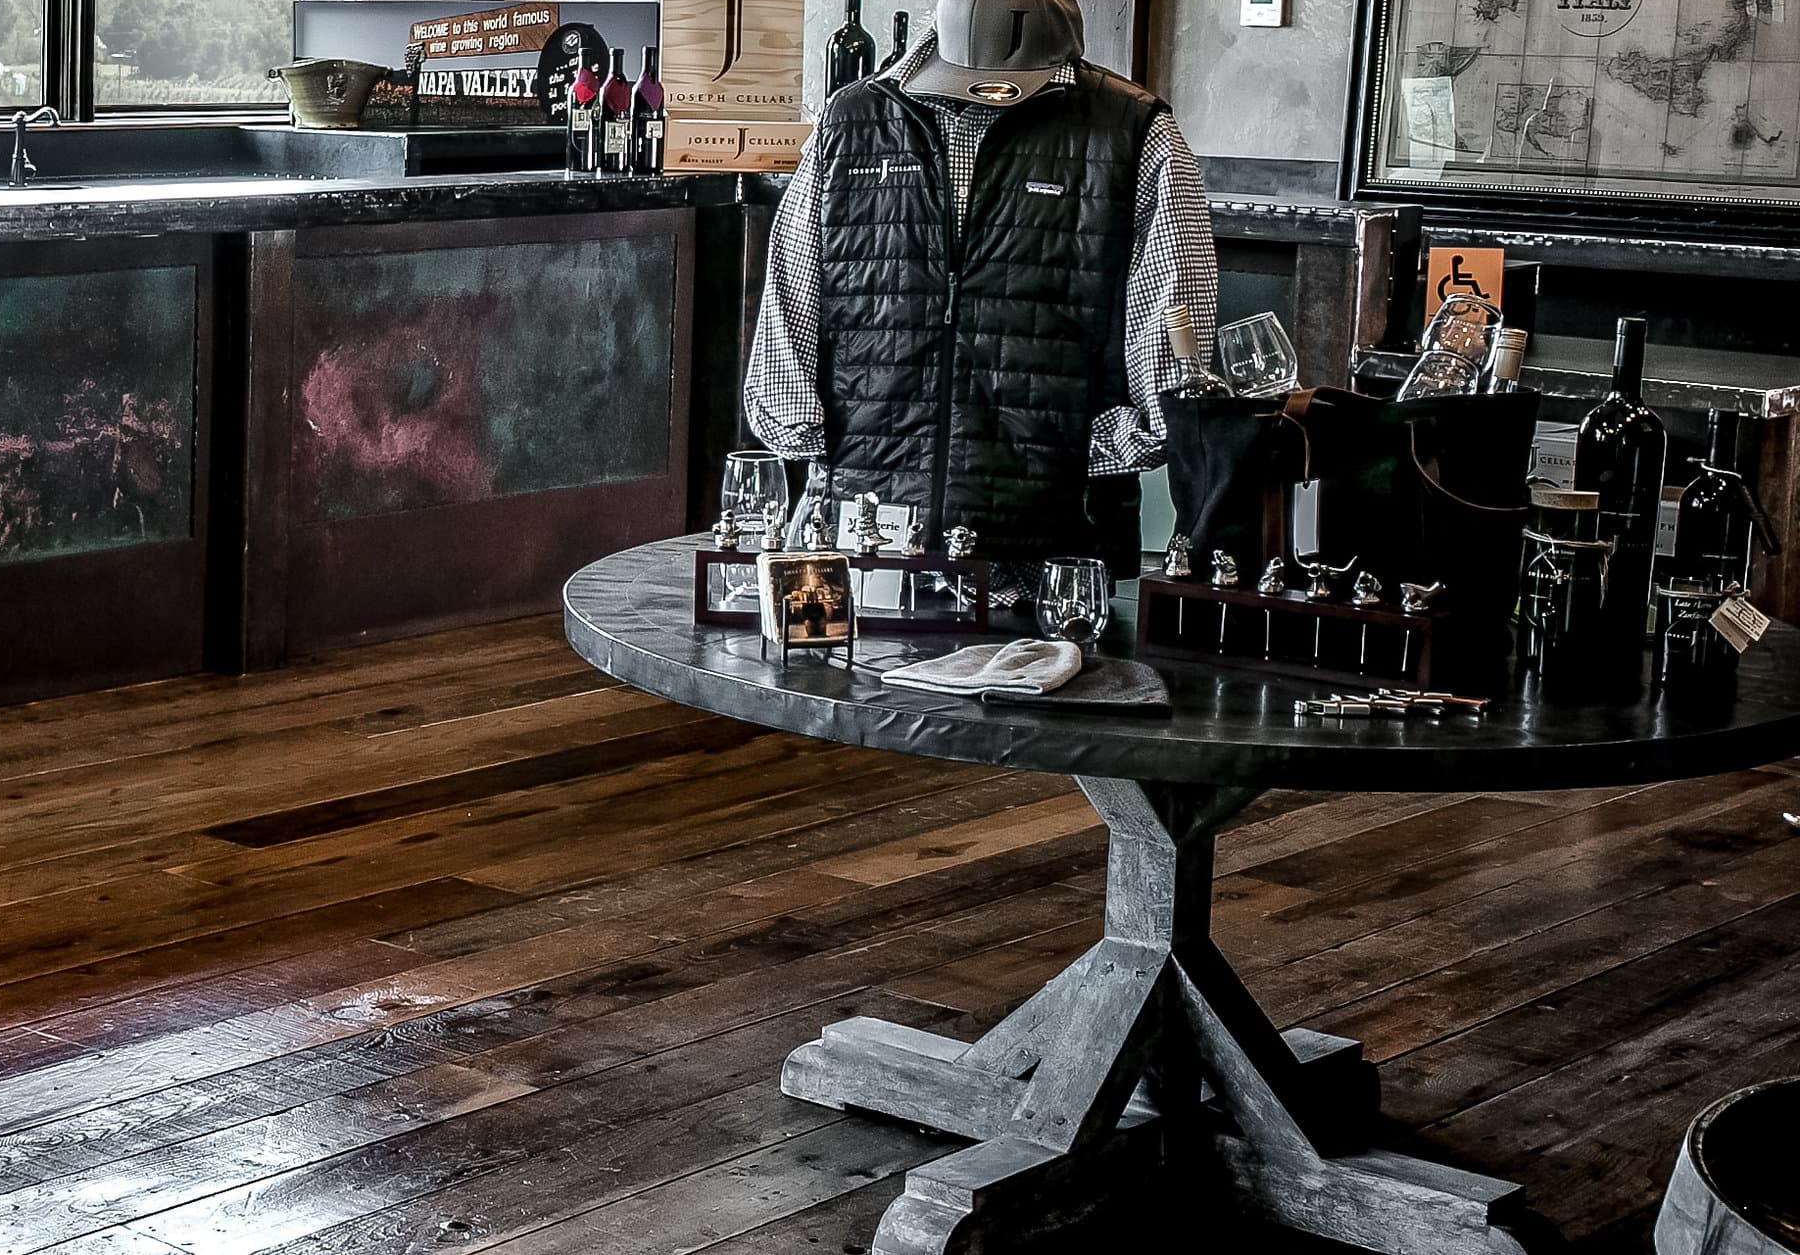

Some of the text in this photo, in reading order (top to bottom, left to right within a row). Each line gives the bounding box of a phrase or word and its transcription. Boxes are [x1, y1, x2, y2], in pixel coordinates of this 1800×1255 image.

[413, 10, 550, 40] WELCOME to this world famous
[1004, 10, 1030, 61] J
[451, 35, 483, 53] growing
[489, 33, 519, 48] region
[418, 69, 538, 98] NAPA VALLEY
[669, 94, 793, 103] JOSEPH CELLARS
[734, 128, 749, 159] J
[879, 159, 890, 184] J
[889, 165, 921, 173] CELLARS
[1540, 456, 1576, 466] CELLA
